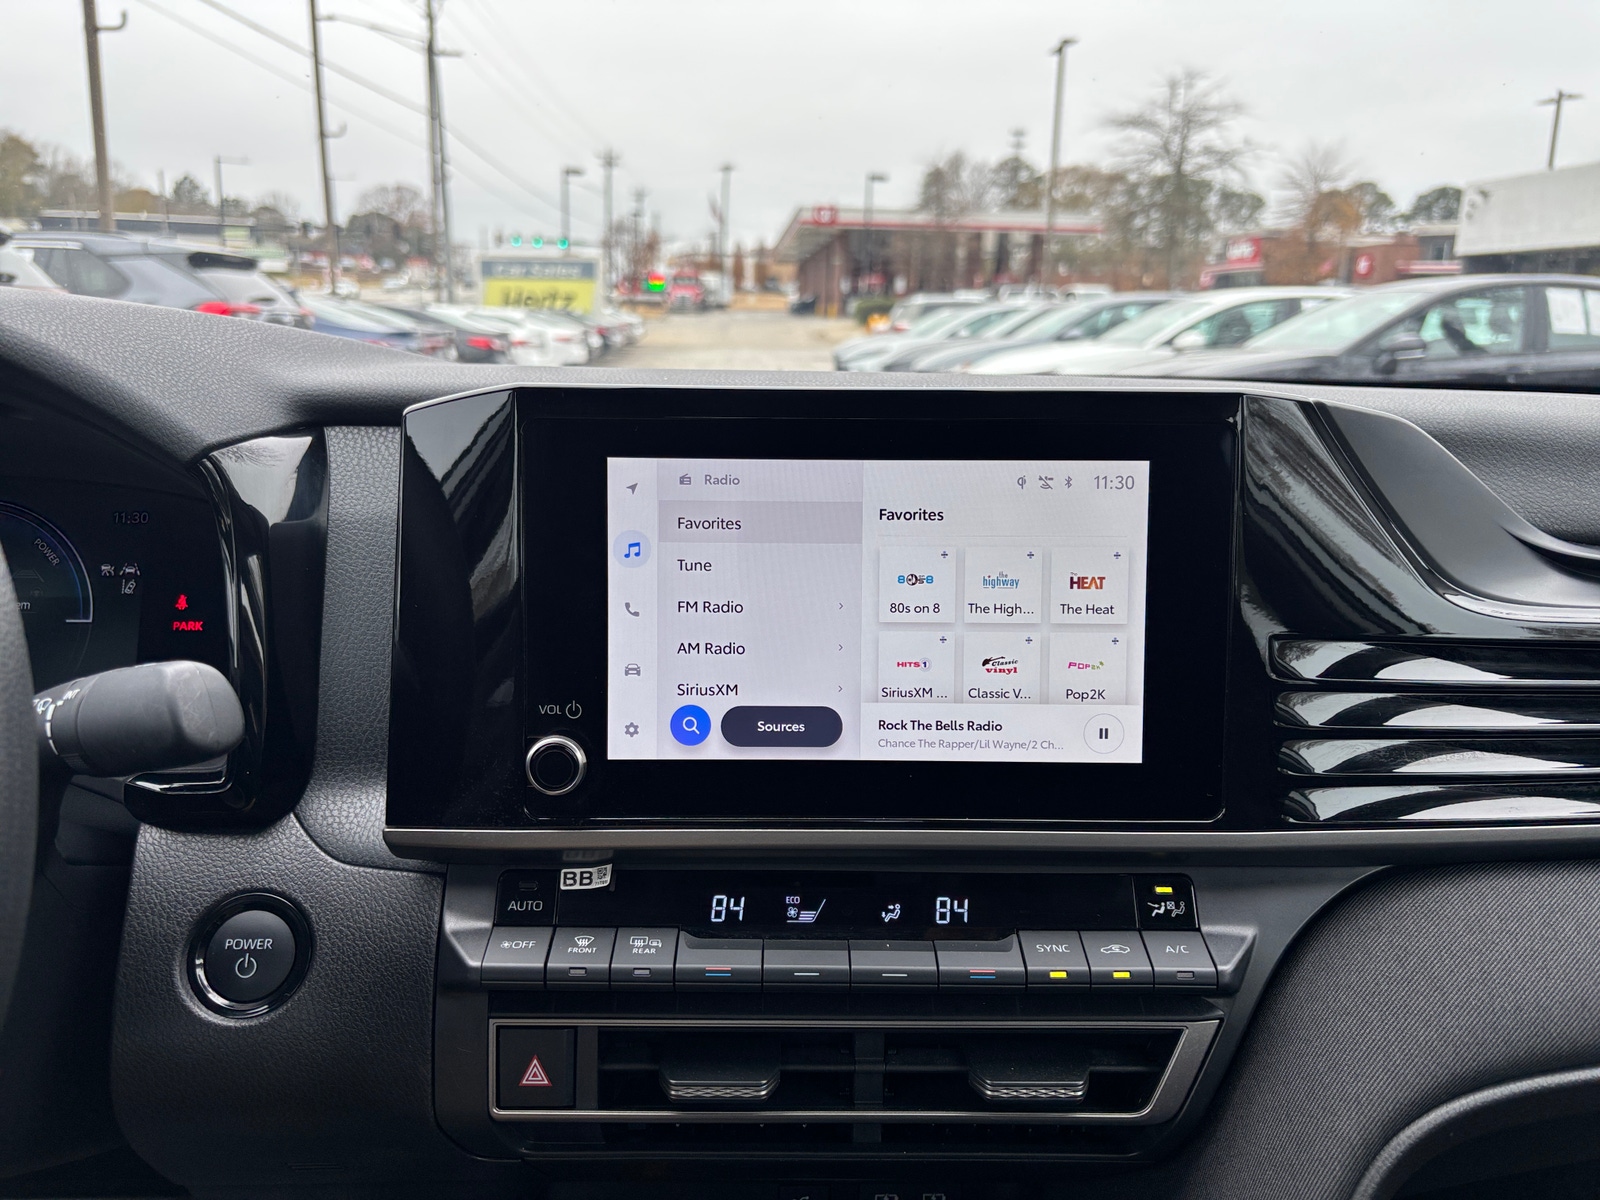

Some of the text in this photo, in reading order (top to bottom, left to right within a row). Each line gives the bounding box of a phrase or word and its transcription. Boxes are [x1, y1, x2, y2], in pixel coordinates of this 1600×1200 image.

[502, 287, 577, 308] Hertz
[704, 473, 741, 486] Radio
[1093, 475, 1135, 490] 11:30
[114, 512, 149, 524] 11:30
[879, 508, 944, 522] Favorites
[677, 516, 742, 531] Favorites
[33, 538, 60, 566] POWER
[676, 558, 712, 572] Tune
[982, 575, 1020, 589] highway
[1069, 576, 1106, 590] HEAT
[677, 600, 744, 614] FM Radio
[889, 602, 941, 614] 80s on 8
[967, 602, 1035, 617] The High...
[1059, 603, 1115, 615] The Heat
[173, 621, 204, 631] PARK
[676, 641, 746, 656] AM Radio
[991, 659, 1019, 667] Classic
[985, 667, 1019, 676] vinyl
[677, 683, 738, 697] SiriusXM
[881, 686, 933, 699] SiriusXM
[967, 687, 1010, 699] Classic
[1065, 688, 1106, 703] Pop2K
[538, 704, 562, 715] VOL
[757, 720, 806, 732] Sources
[878, 719, 1003, 732] Rock The Bells Radio
[878, 738, 916, 749] Chance
[917, 738, 936, 749] The
[938, 738, 991, 751] Rapper/Lil
[992, 739, 1038, 752] Wayne/2
[563, 870, 593, 887] BB
[507, 900, 543, 911] AUTO
[785, 896, 801, 905] ECO
[710, 895, 746, 923] 84
[935, 896, 969, 924] 84
[224, 938, 273, 950] POWER
[511, 940, 536, 949] OFF
[567, 946, 597, 954] FRONT
[1035, 944, 1071, 953] SYNC
[1165, 945, 1190, 954] A/C
